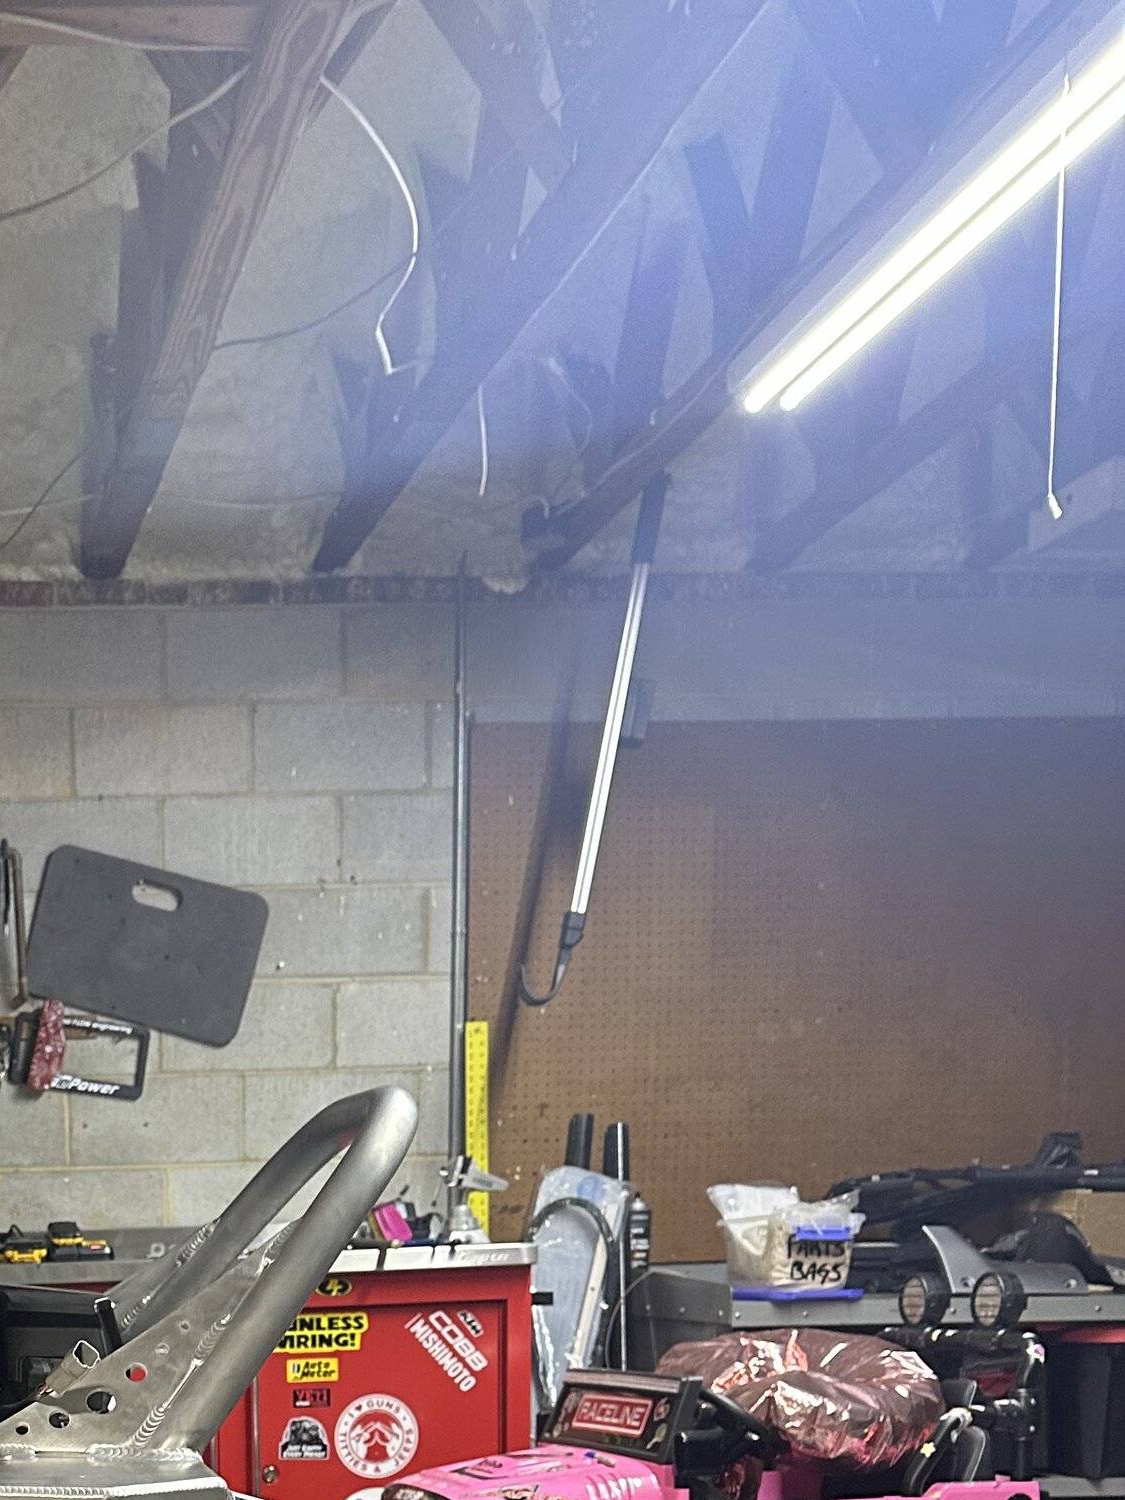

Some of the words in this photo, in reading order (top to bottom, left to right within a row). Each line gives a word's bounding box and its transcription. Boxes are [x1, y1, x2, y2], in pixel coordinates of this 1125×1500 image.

[790, 1260, 845, 1285] BAGS
[409, 1318, 477, 1392] MISHIMOTO
[429, 1310, 488, 1372] COBB
